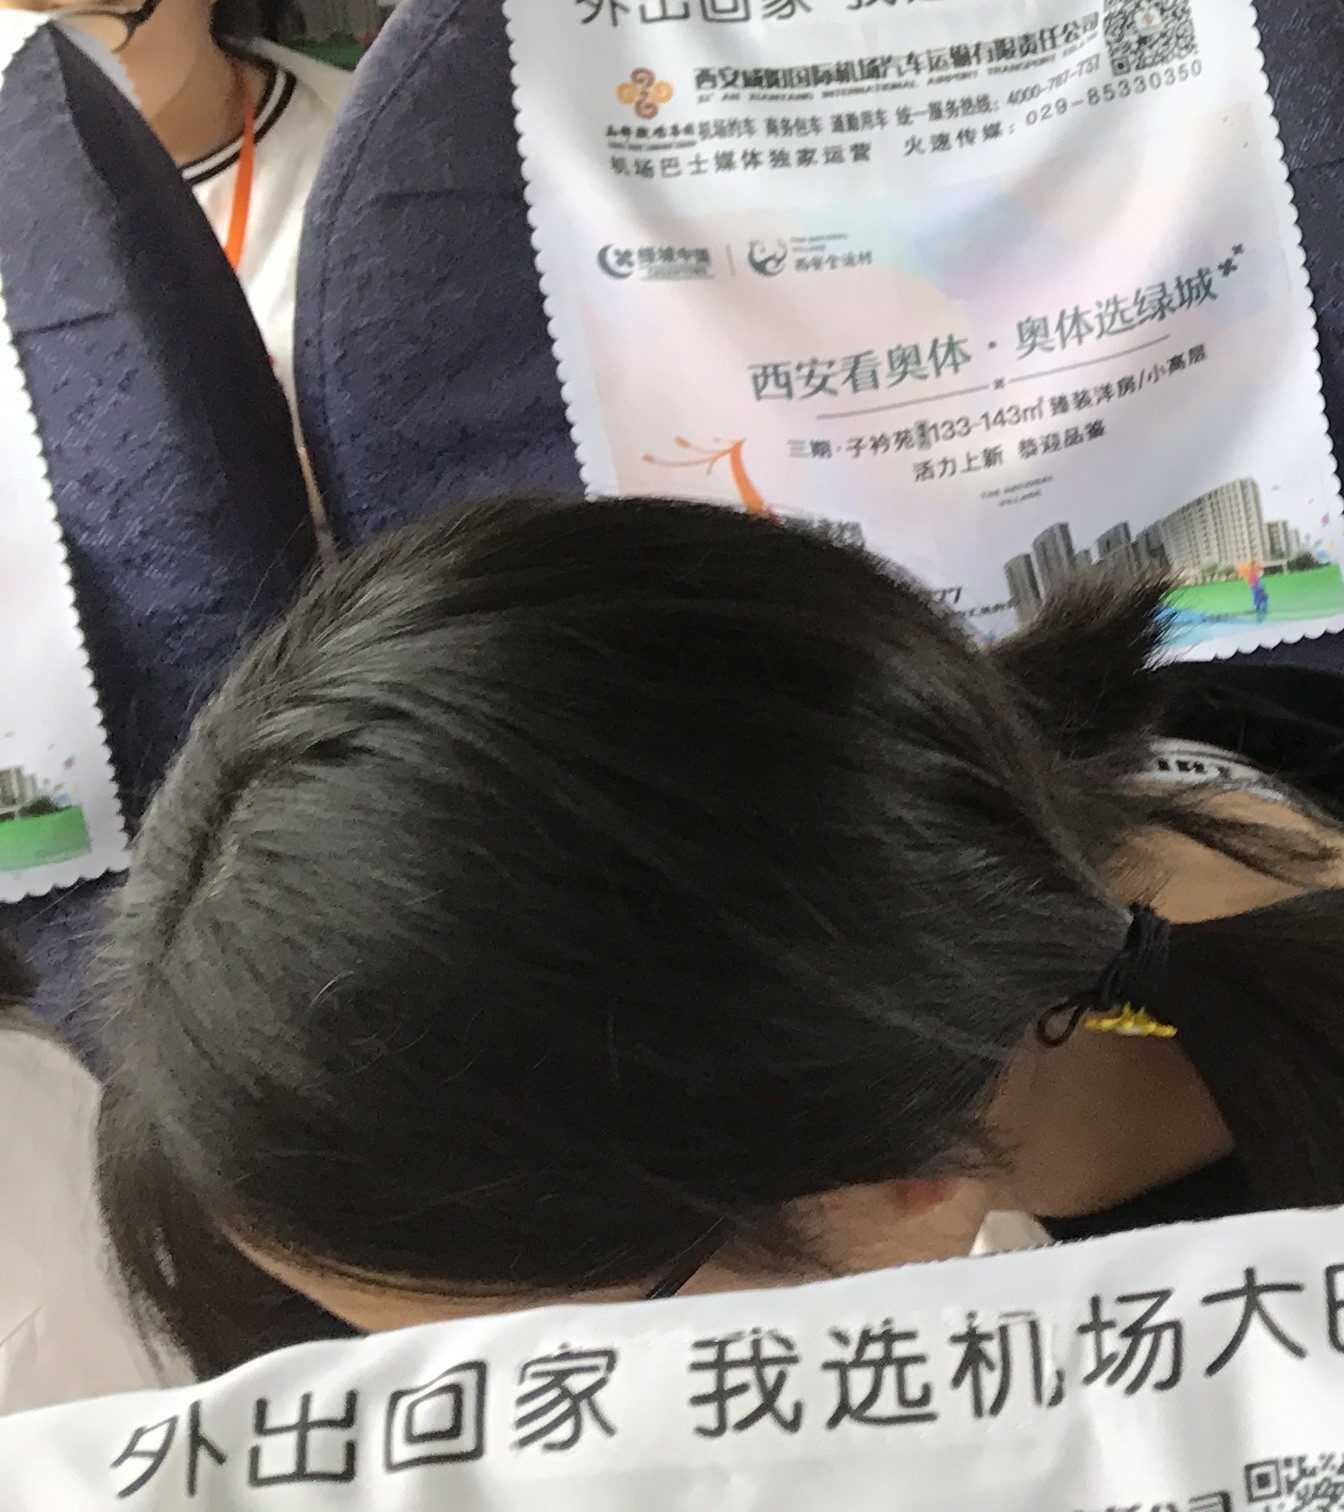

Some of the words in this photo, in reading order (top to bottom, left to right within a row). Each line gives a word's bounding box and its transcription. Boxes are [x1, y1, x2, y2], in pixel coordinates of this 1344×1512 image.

[609, 140, 873, 179] 机场巴士媒体独家运营
[1025, 59, 1202, 126] 029-85330350
[912, 443, 1005, 483] 活力上新
[110, 1343, 618, 1500] 外出回家
